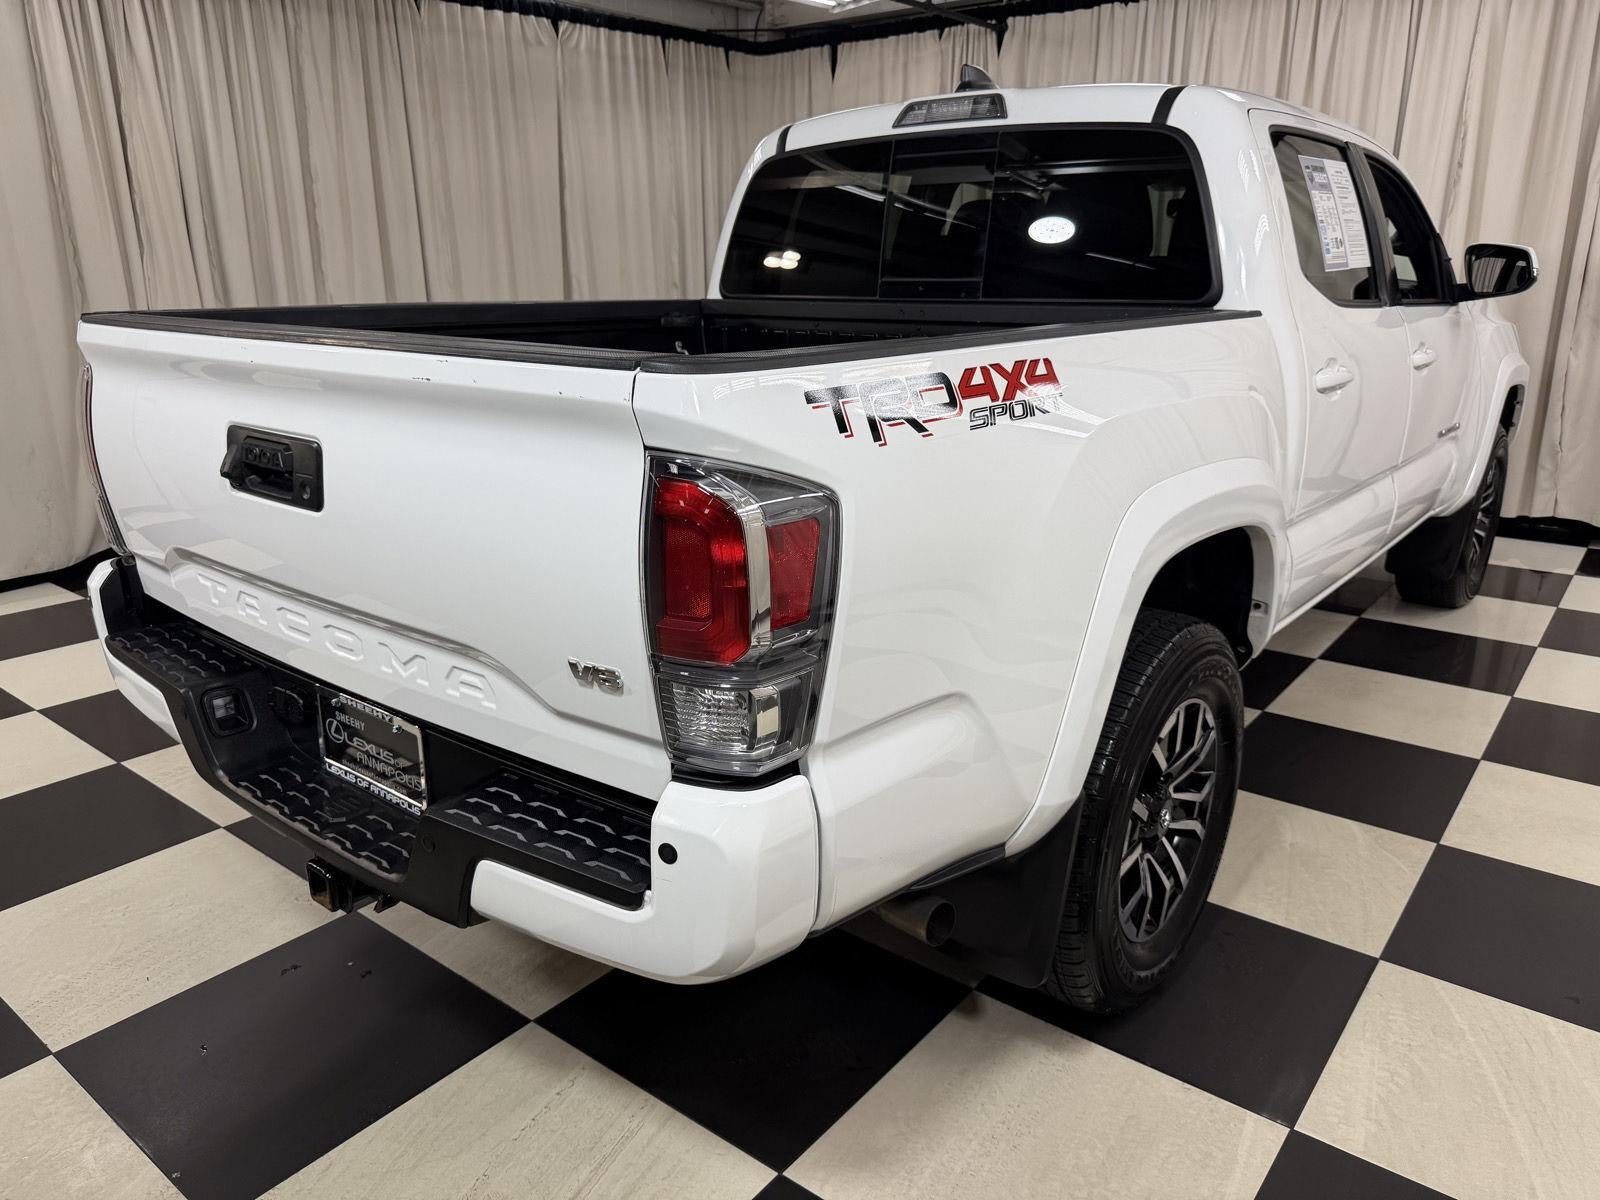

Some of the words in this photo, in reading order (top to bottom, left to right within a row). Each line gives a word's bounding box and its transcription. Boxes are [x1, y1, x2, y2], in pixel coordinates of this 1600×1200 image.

[803, 371, 964, 447] TRD
[969, 392, 1064, 431] SPORT
[197, 573, 497, 709] TACOMA
[567, 656, 625, 690] V6
[335, 710, 365, 731] SHEEHY
[339, 695, 391, 722] SHEEHY
[344, 732, 395, 765] LEXUS
[325, 763, 356, 783] LEXUS
[357, 778, 370, 788] OF
[370, 784, 421, 816] ANNAPOLIS
[356, 751, 422, 792] ANNAPOLIS
